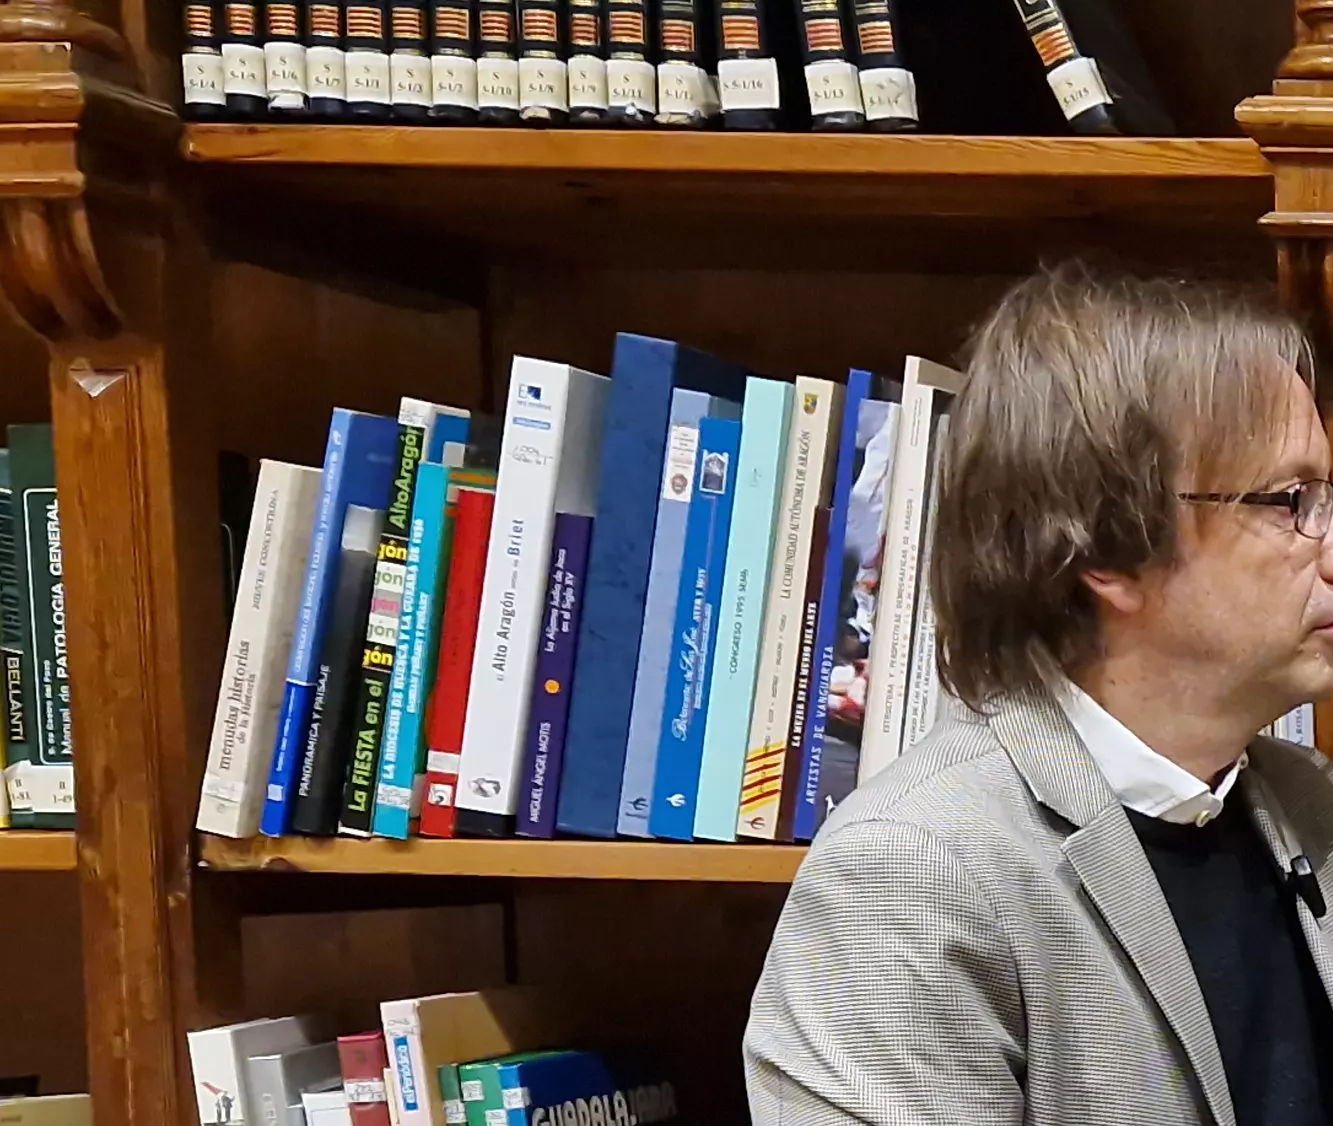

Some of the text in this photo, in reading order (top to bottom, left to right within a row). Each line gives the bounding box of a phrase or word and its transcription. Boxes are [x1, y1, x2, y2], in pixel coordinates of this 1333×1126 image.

[45, 499, 62, 576] GENERAL
[50, 582, 69, 679] PATOLOGIA
[3, 656, 27, 740] BELLANTI
[346, 678, 383, 812] La FIESTA en el
[804, 644, 834, 804] ARTISTAS DE VANGUARDIA
